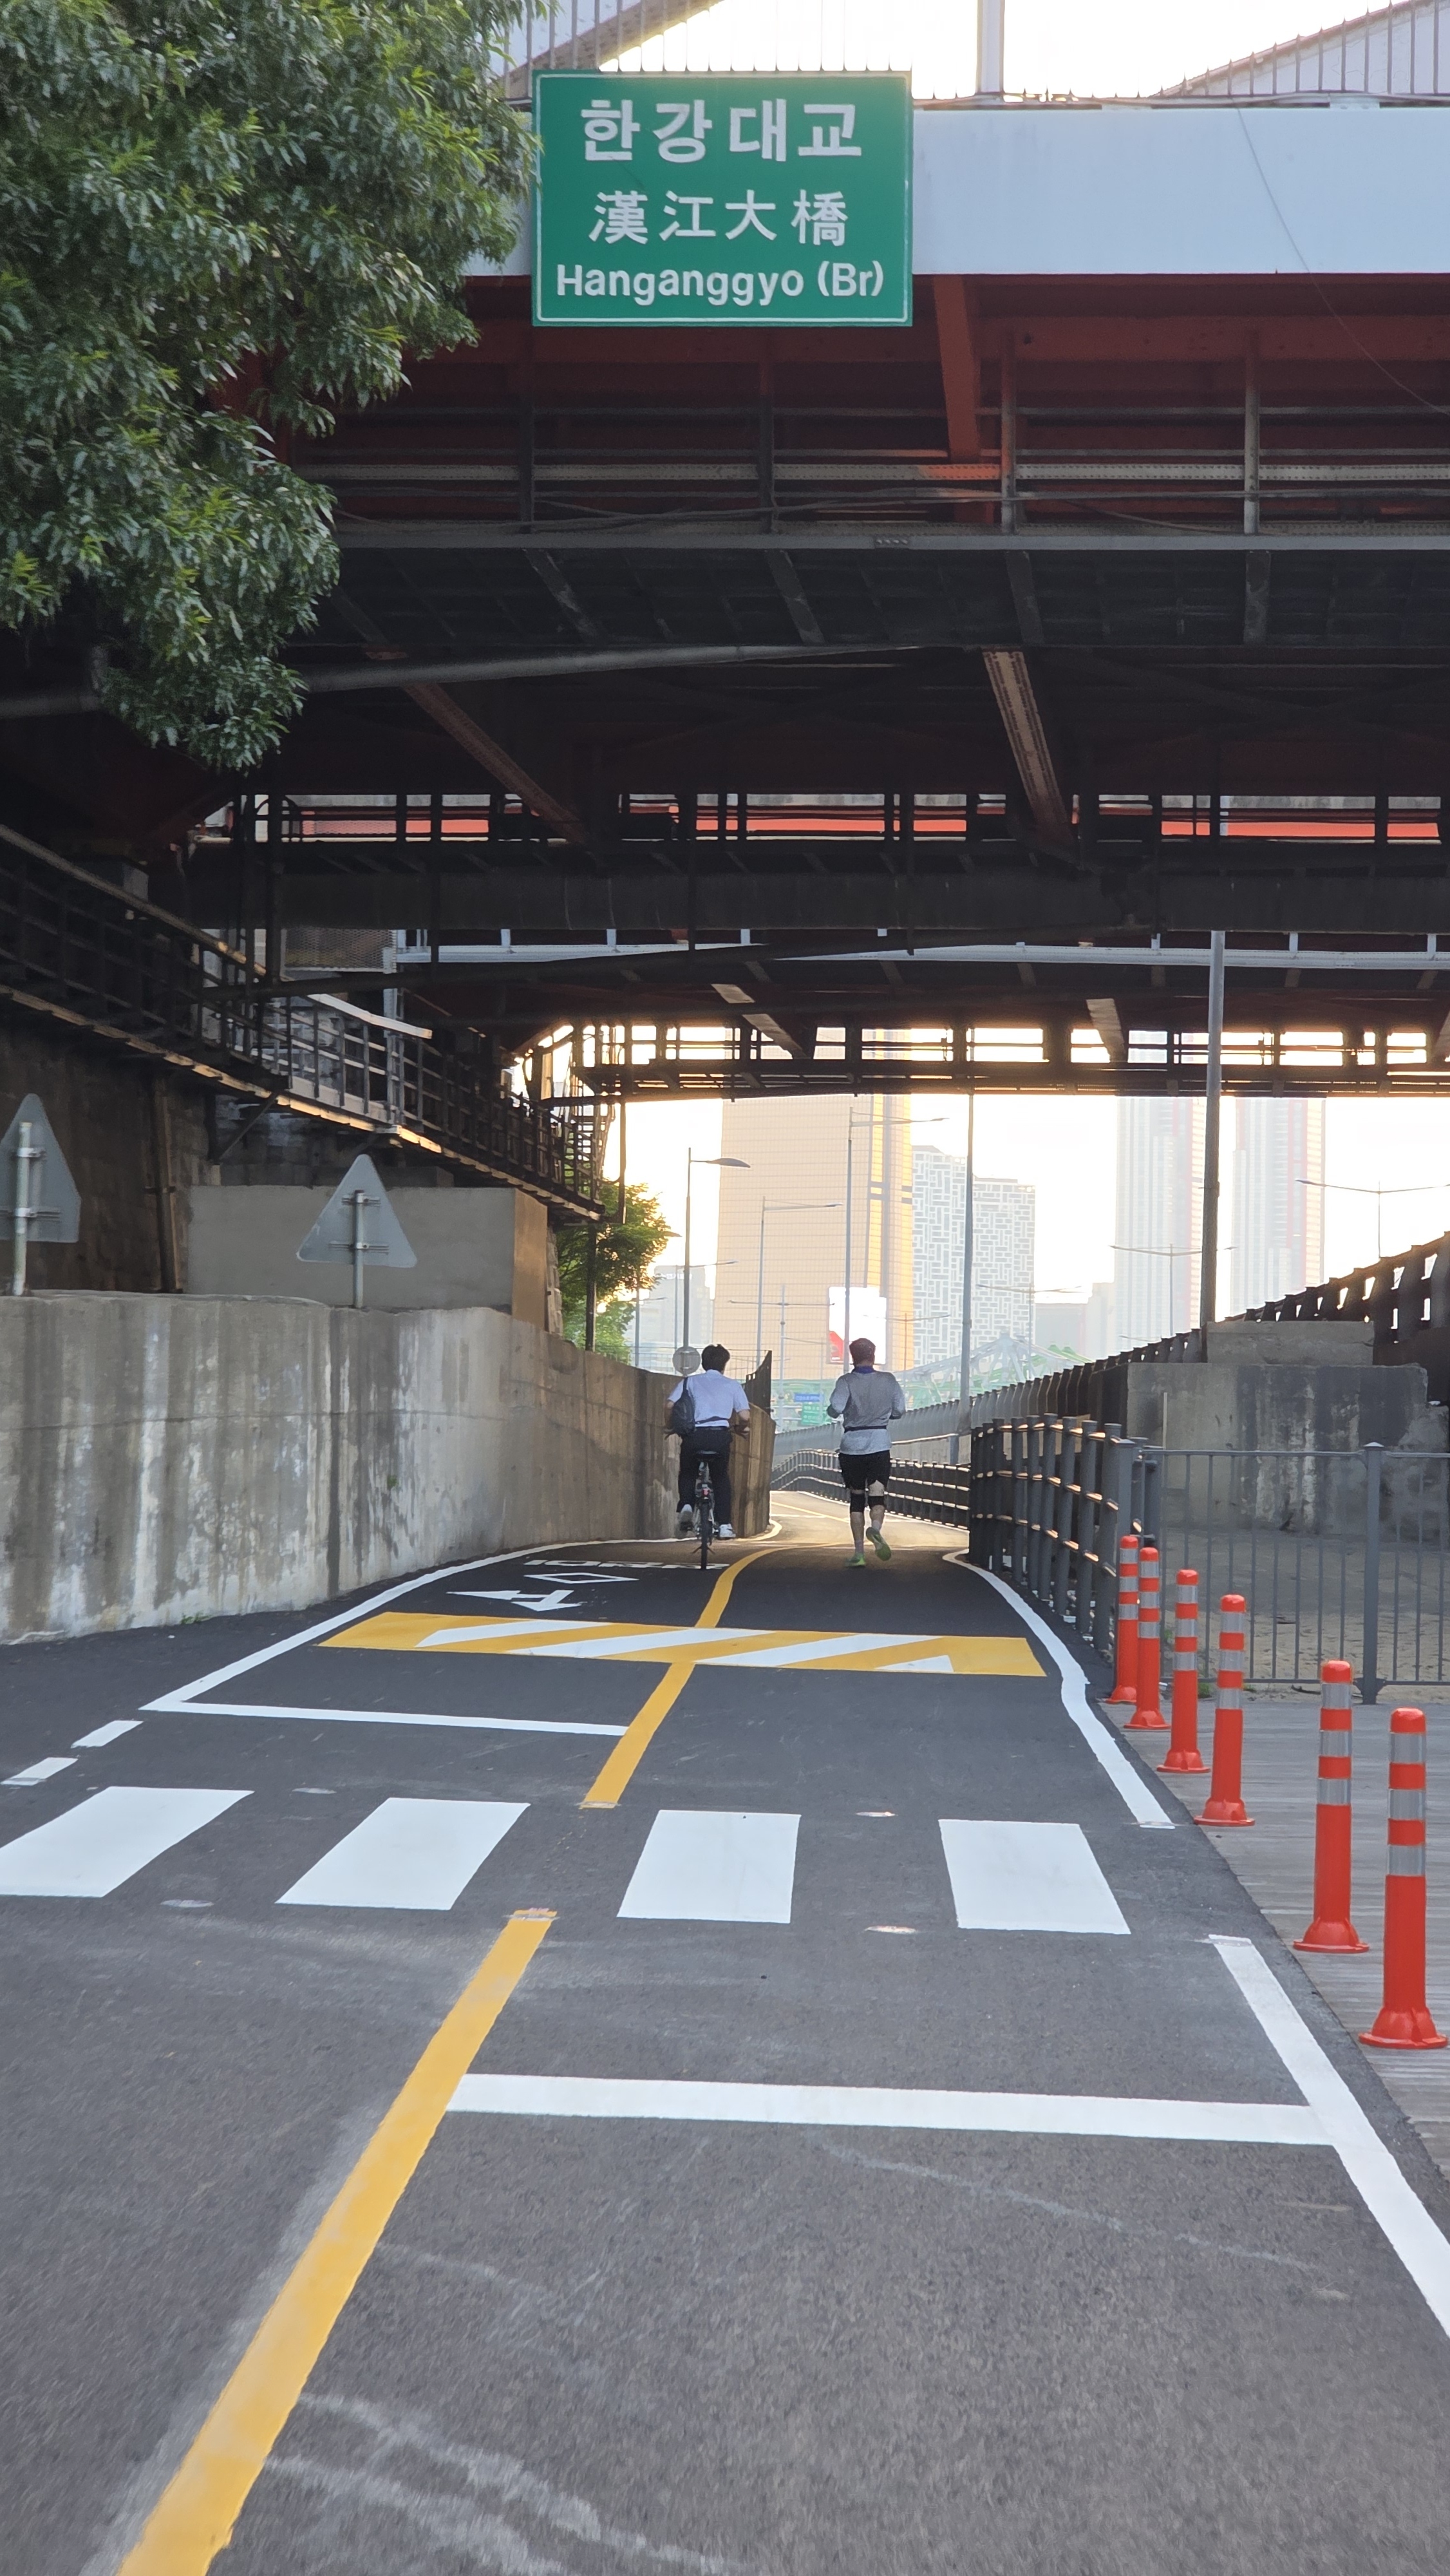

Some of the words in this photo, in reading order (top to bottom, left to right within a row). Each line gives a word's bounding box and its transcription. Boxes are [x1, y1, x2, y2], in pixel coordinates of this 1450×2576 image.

[581, 98, 862, 163] 한강대교
[588, 189, 849, 247] 漢江大橋
[557, 264, 804, 306] Hanganggyo
[817, 260, 884, 297] (Br)
